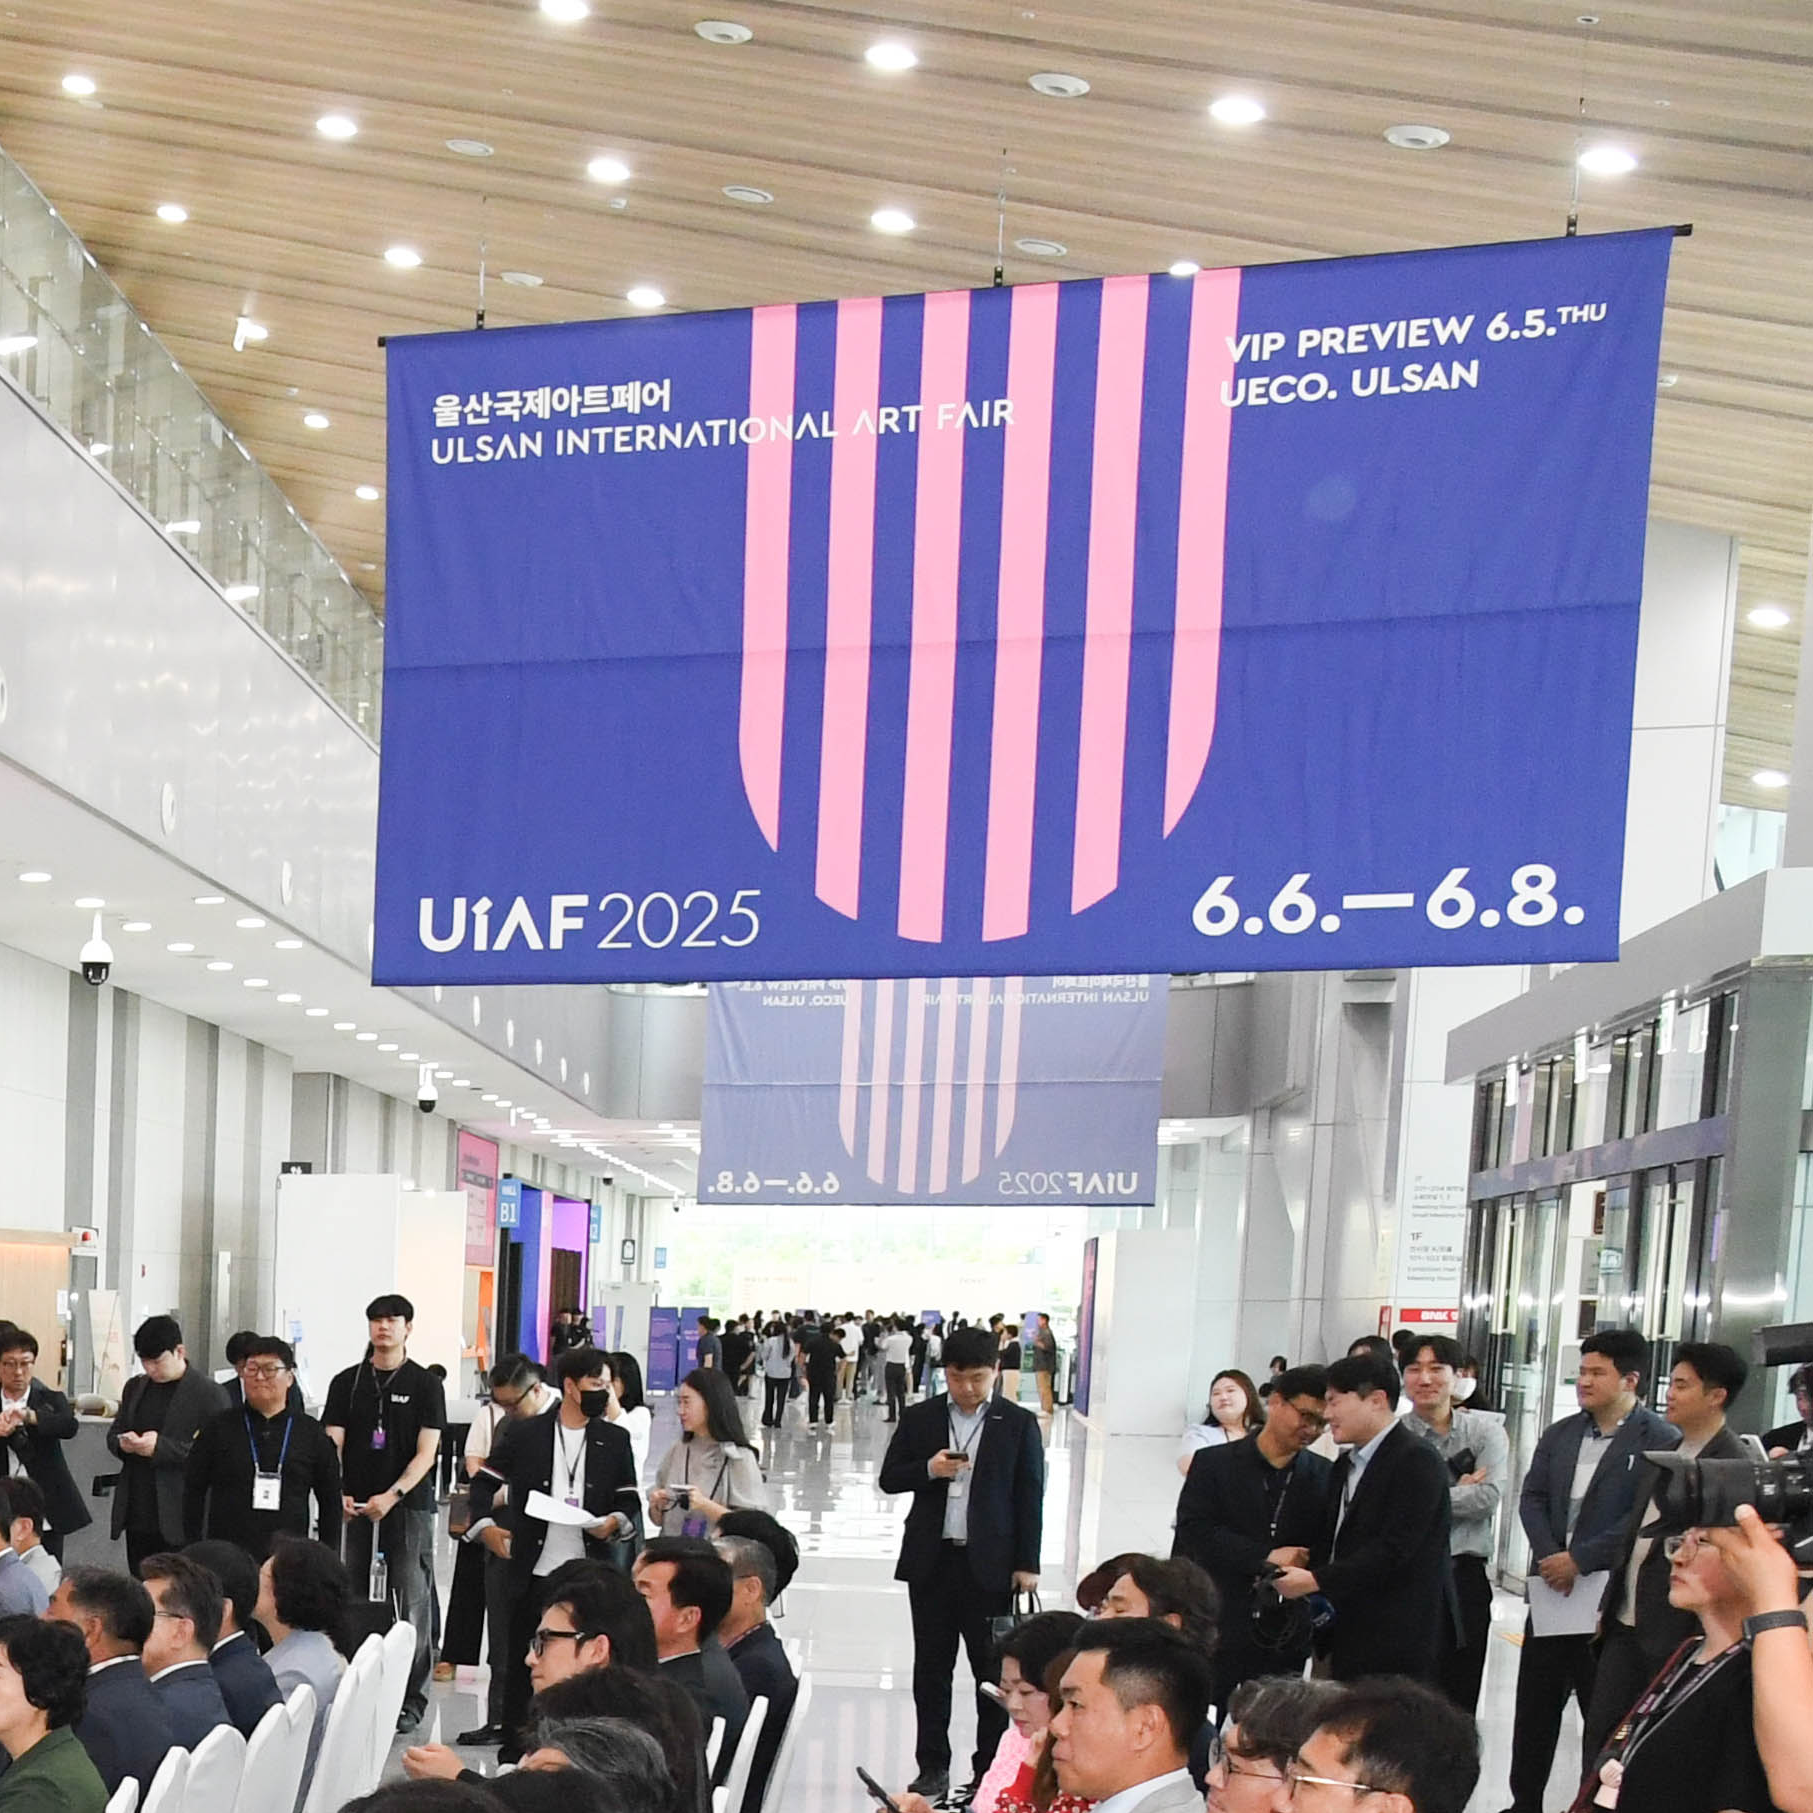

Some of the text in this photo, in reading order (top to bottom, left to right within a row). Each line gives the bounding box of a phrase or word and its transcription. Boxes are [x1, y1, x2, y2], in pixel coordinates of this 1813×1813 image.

[1225, 332, 1285, 363] VIP
[1298, 315, 1475, 358] PREVIEW
[433, 379, 671, 428] 울산국제아트페어
[1220, 359, 1479, 408] UECO. ULSAN
[431, 399, 1016, 465] ULSAN INTERNATIONAL ART FAIR
[597, 889, 762, 949] 2025
[500, 1203, 517, 1223] B1
